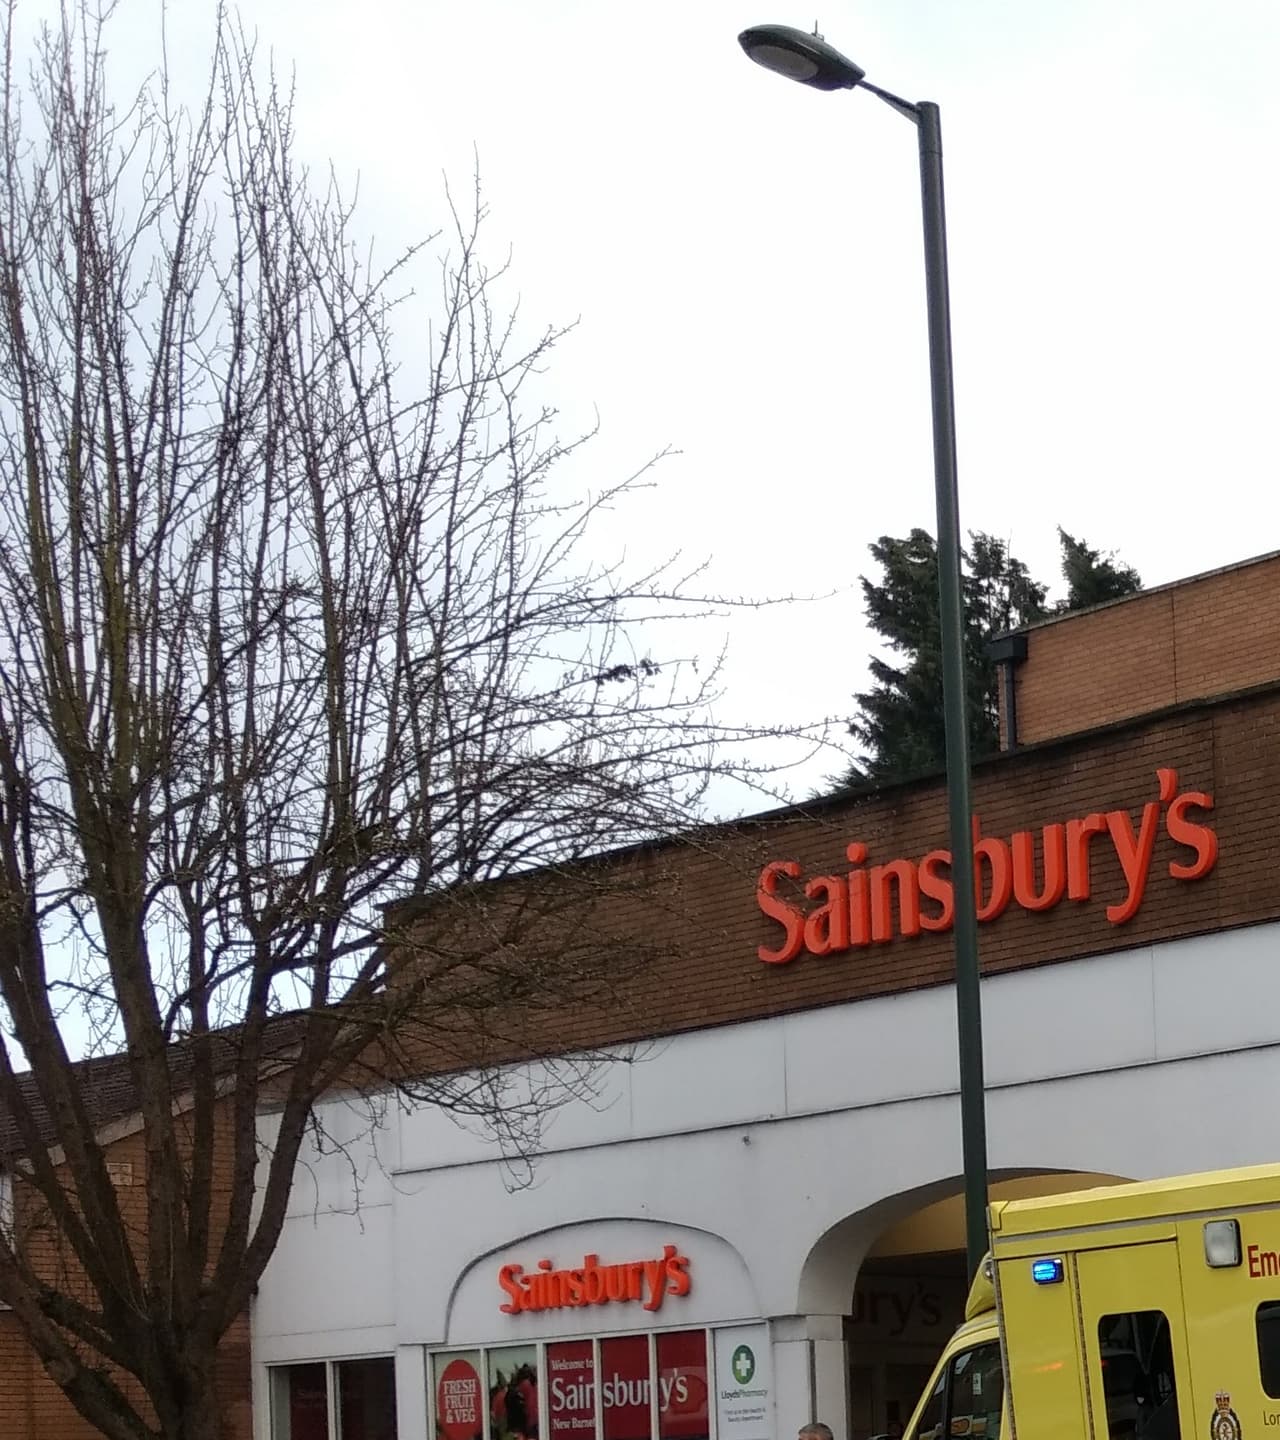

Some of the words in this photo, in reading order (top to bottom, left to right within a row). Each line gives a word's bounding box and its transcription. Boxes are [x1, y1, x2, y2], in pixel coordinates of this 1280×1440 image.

[757, 768, 1218, 964] Sainsbury's
[499, 1245, 692, 1316] Sainsbury's
[551, 1359, 584, 1371] Welcome
[443, 1379, 476, 1394] FRESH
[552, 1368, 688, 1412] Sainsbury's
[444, 1394, 475, 1409] FRUIT
[455, 1408, 476, 1423] VEG
[553, 1419, 570, 1430] New
